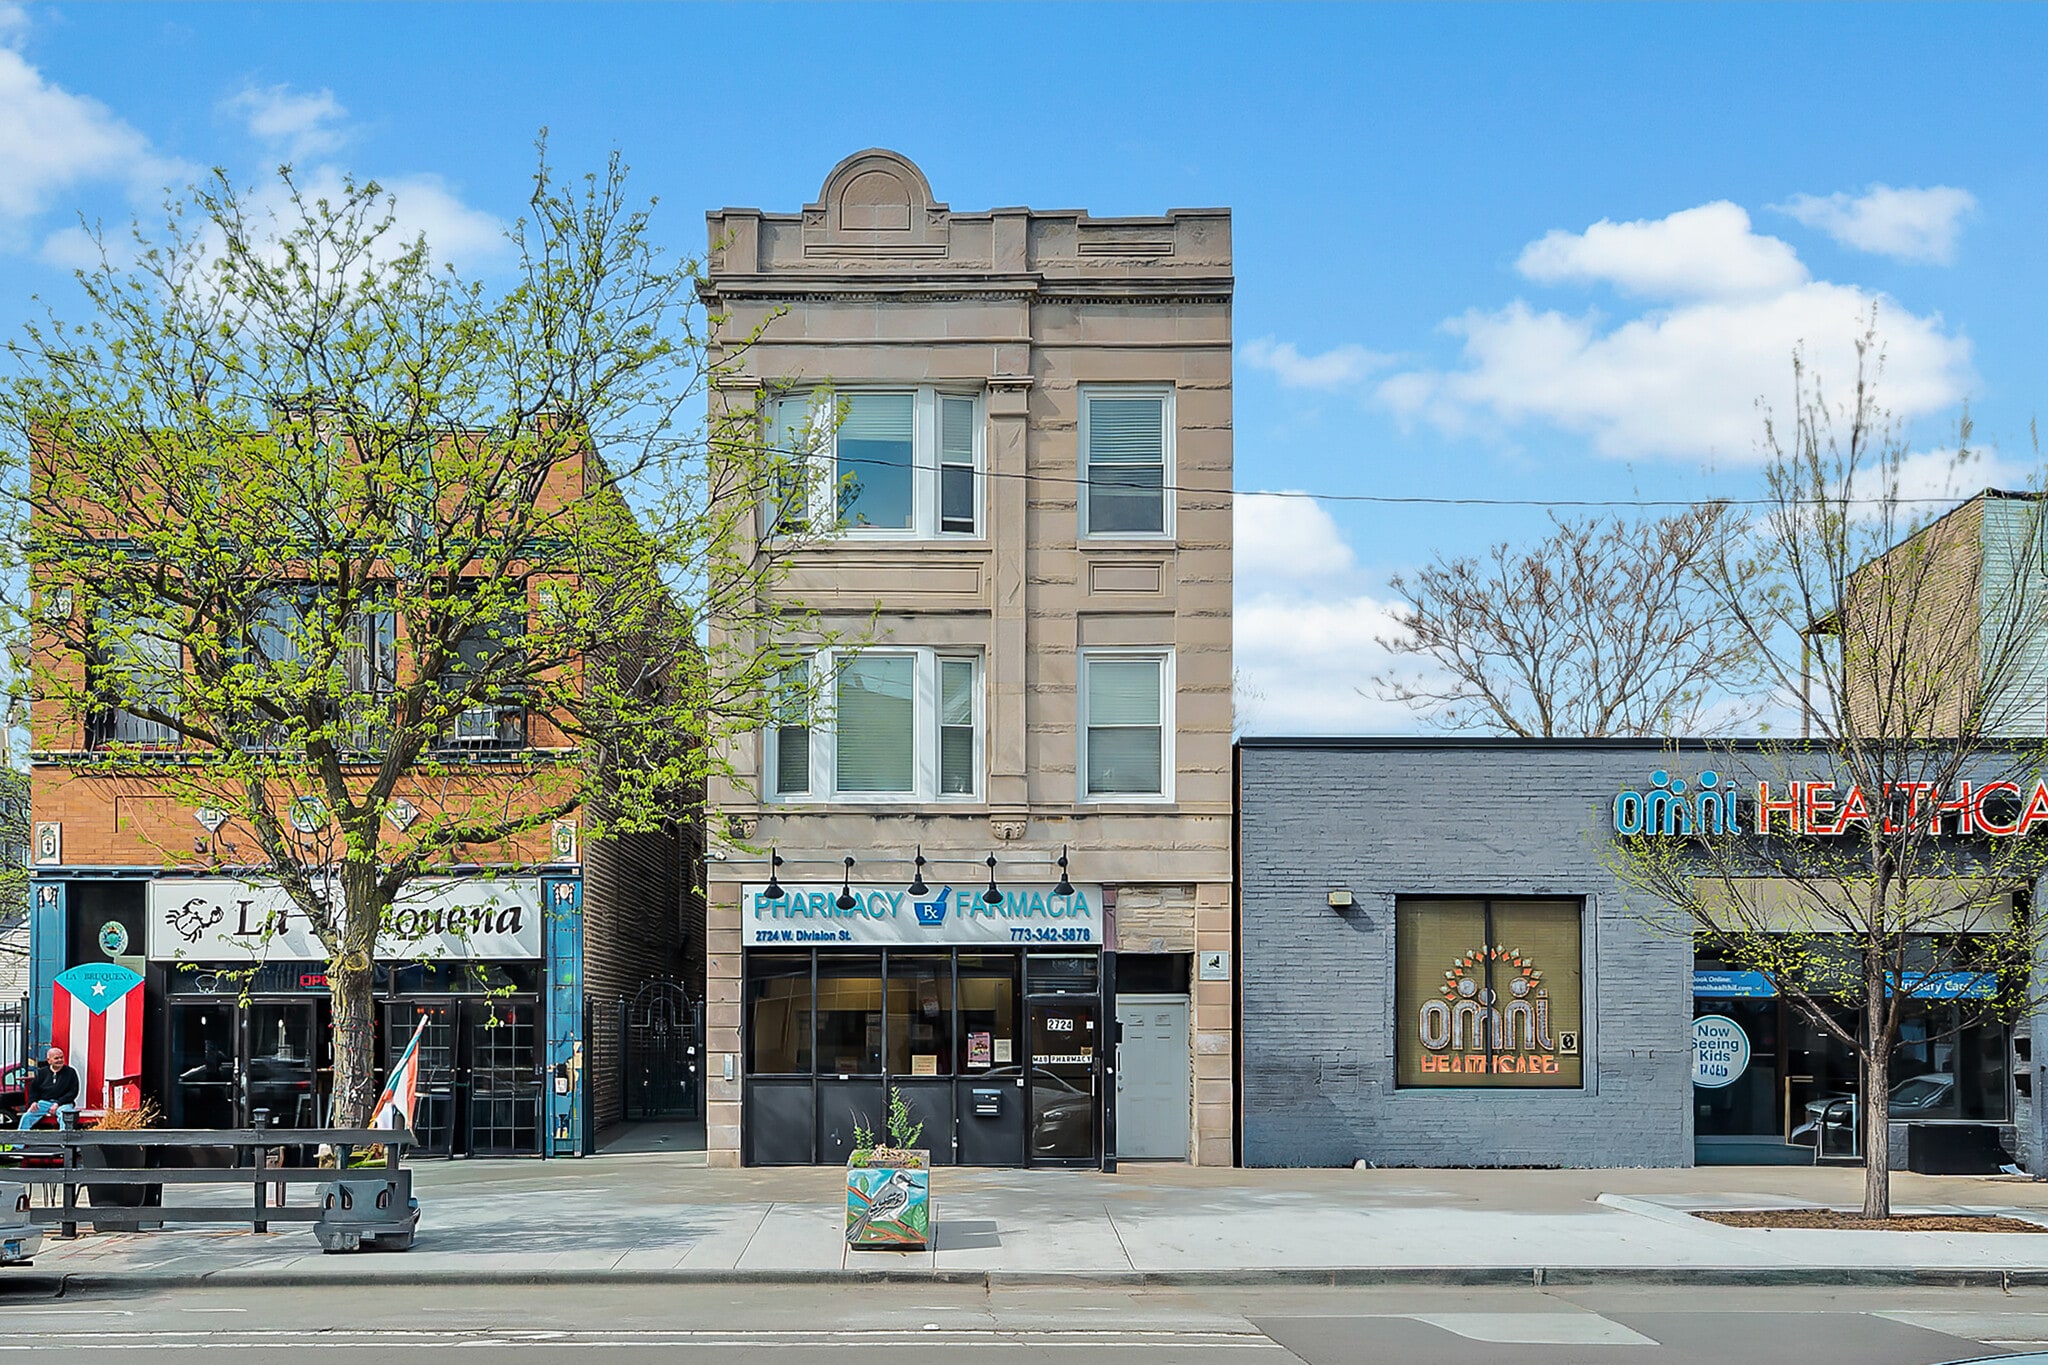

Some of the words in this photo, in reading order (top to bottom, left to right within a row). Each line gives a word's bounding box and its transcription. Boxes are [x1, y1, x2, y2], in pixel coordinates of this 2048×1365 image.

[1614, 779, 1742, 836] omni
[755, 892, 903, 918] PHARMACY
[956, 891, 1091, 917] FARMACIA
[233, 900, 289, 935] La
[756, 930, 779, 941] 2724
[781, 930, 793, 941] W.
[796, 930, 836, 941] Division
[838, 930, 852, 941] St.
[1010, 927, 1091, 941] 773-342-5878
[65, 972, 77, 981] LA
[300, 974, 330, 986] OPE
[1901, 980, 1941, 994] riary
[1048, 1019, 1072, 1030] 2724
[1419, 988, 1555, 1051] omni
[1698, 1025, 1730, 1037] Now
[1692, 1037, 1739, 1052] Seeing
[1700, 1050, 1731, 1061] Kids
